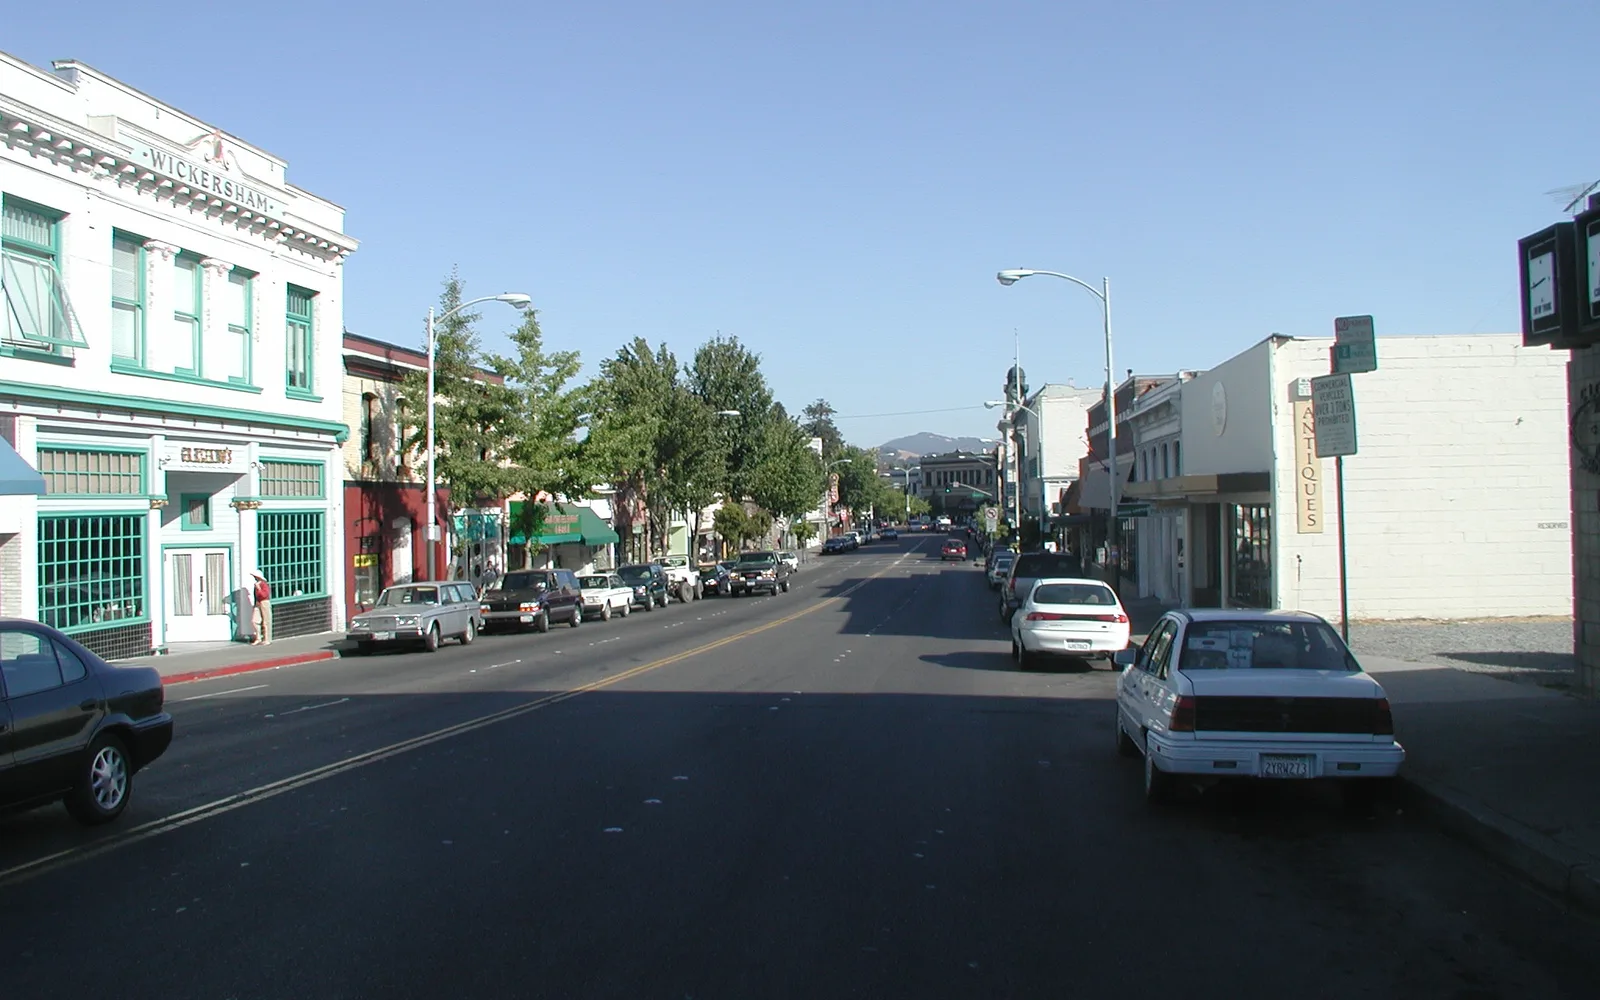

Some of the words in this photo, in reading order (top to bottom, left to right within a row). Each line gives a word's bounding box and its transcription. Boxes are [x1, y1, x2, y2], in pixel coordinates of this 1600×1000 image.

[150, 148, 268, 213] WICKERSHAM
[1315, 378, 1348, 392] COMMERCIAL
[1319, 389, 1345, 402] VEHICLES
[1315, 403, 1329, 416] OVER
[1335, 399, 1351, 413] TONS
[1317, 413, 1350, 426] PROHIBITED
[1301, 406, 1318, 527] ANTIQUES
